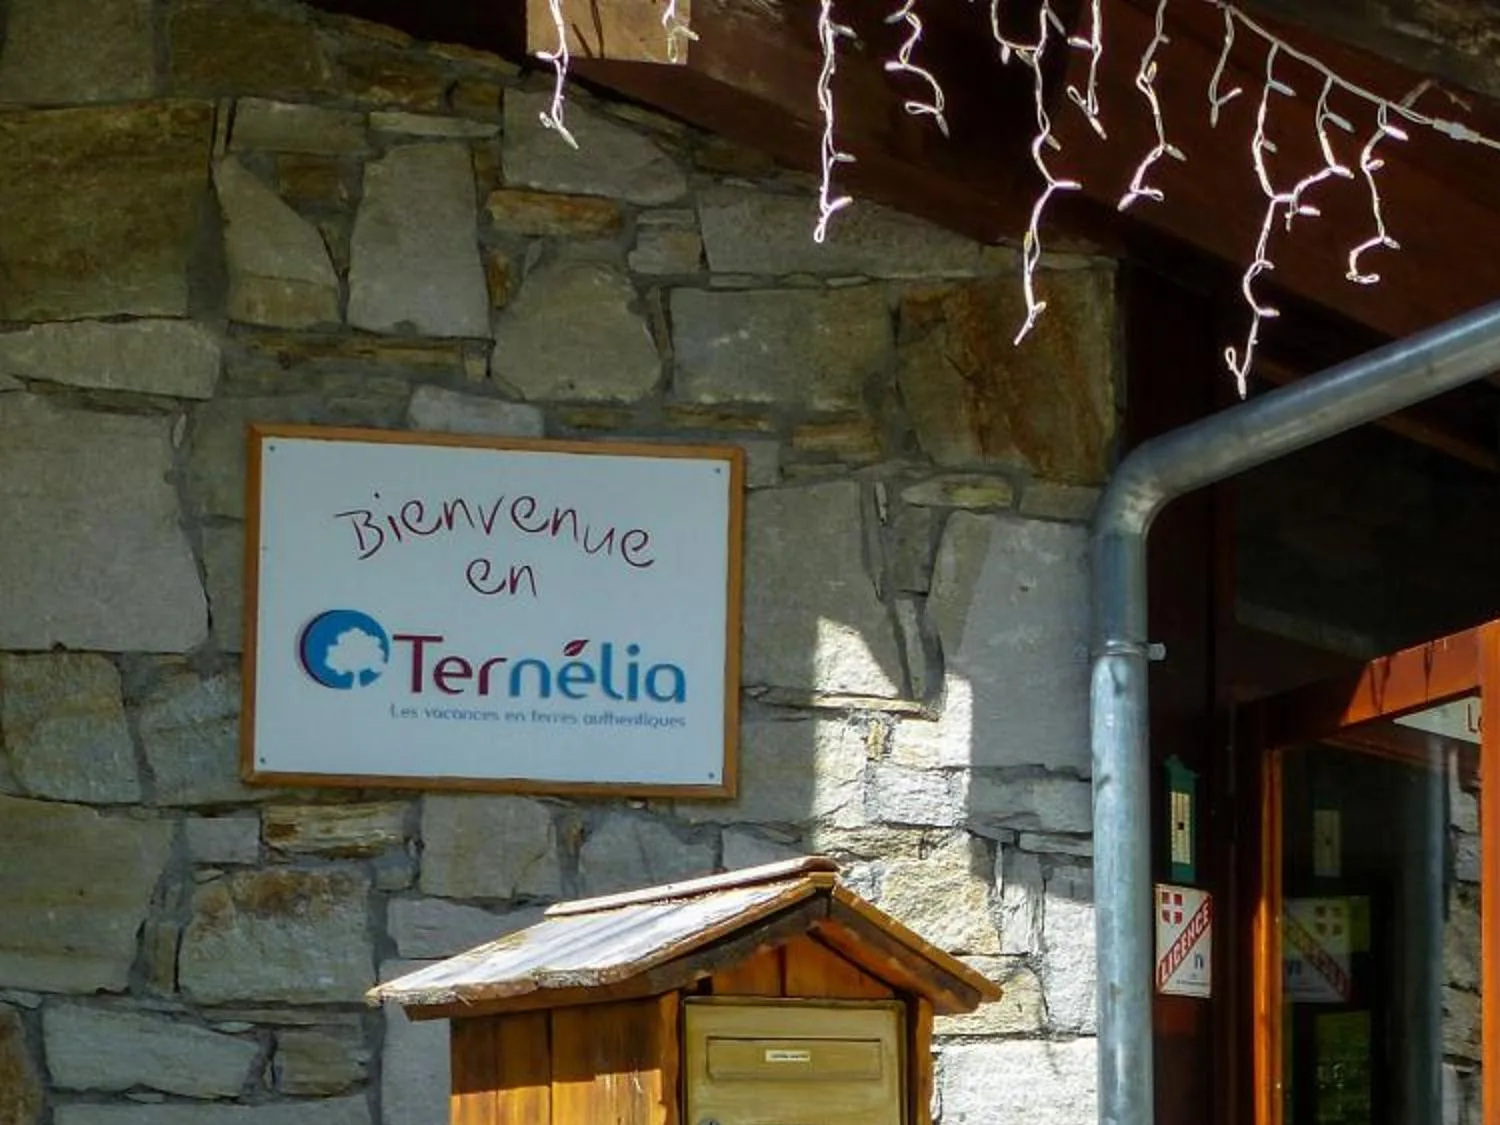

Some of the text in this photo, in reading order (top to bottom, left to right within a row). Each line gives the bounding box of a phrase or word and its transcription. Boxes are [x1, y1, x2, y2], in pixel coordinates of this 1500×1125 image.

[335, 492, 657, 568] Bienvenue
[466, 557, 538, 597] en
[392, 635, 687, 703] Ternélia
[390, 703, 419, 719] Les
[425, 708, 499, 722] vacances
[505, 711, 526, 722] en
[583, 710, 687, 729] authentiques
[1159, 899, 1210, 987] LICENCE
